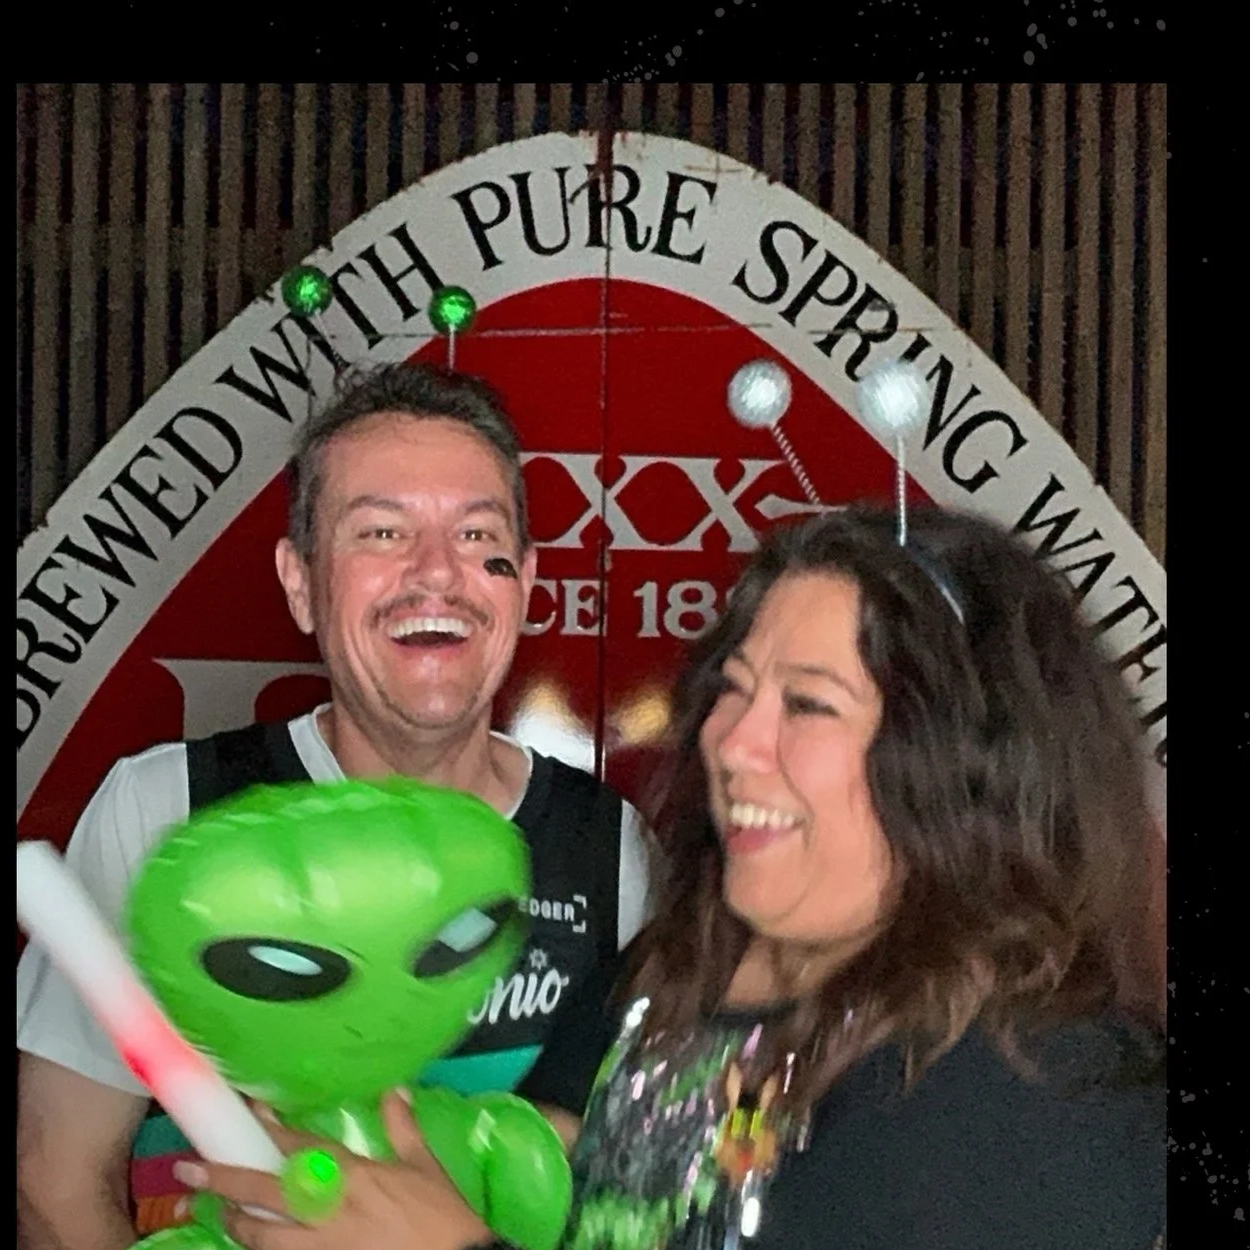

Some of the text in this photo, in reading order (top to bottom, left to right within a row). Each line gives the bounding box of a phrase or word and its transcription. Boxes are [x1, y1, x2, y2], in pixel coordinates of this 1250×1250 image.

[451, 163, 717, 271] PURE
[1011, 472, 1166, 768] WATE
[633, 580, 735, 639] 18
